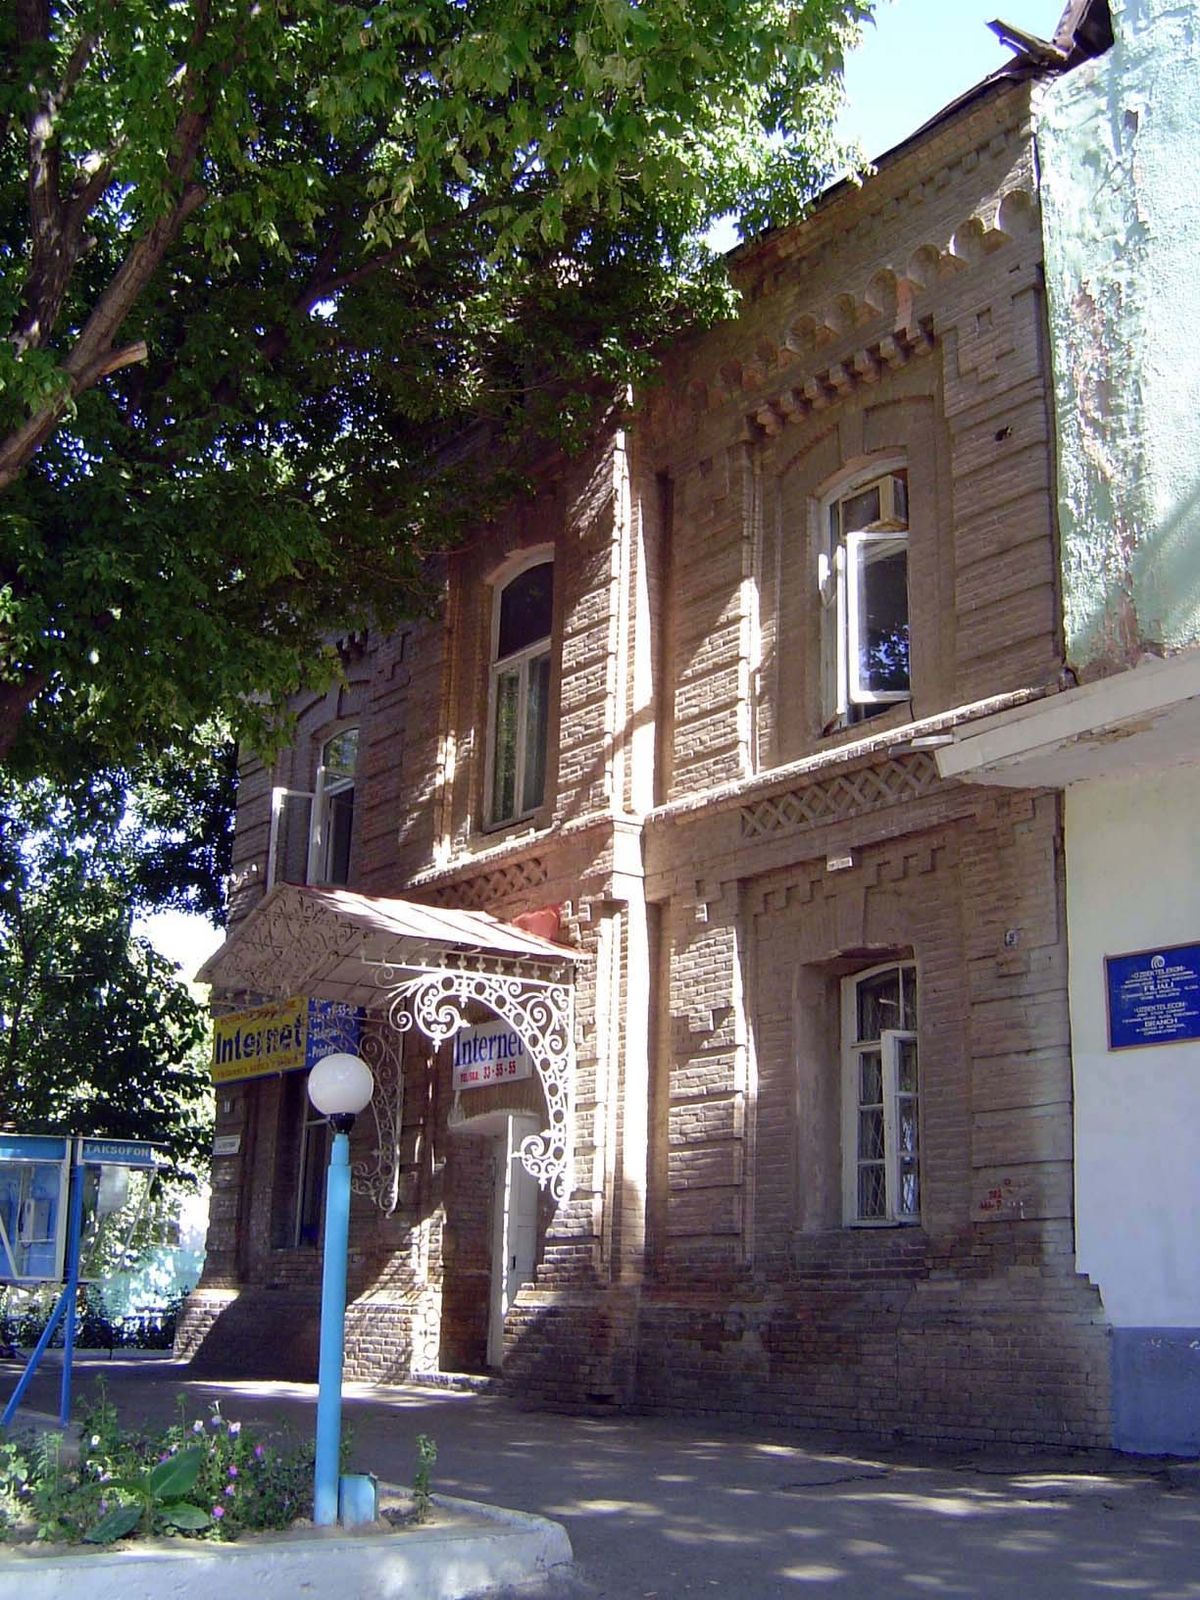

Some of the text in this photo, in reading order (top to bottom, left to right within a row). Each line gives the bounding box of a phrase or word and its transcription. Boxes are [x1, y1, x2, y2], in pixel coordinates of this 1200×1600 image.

[215, 1013, 302, 1064] Internet
[455, 1027, 524, 1066] Internet
[85, 1143, 149, 1157] TAKSOFON
